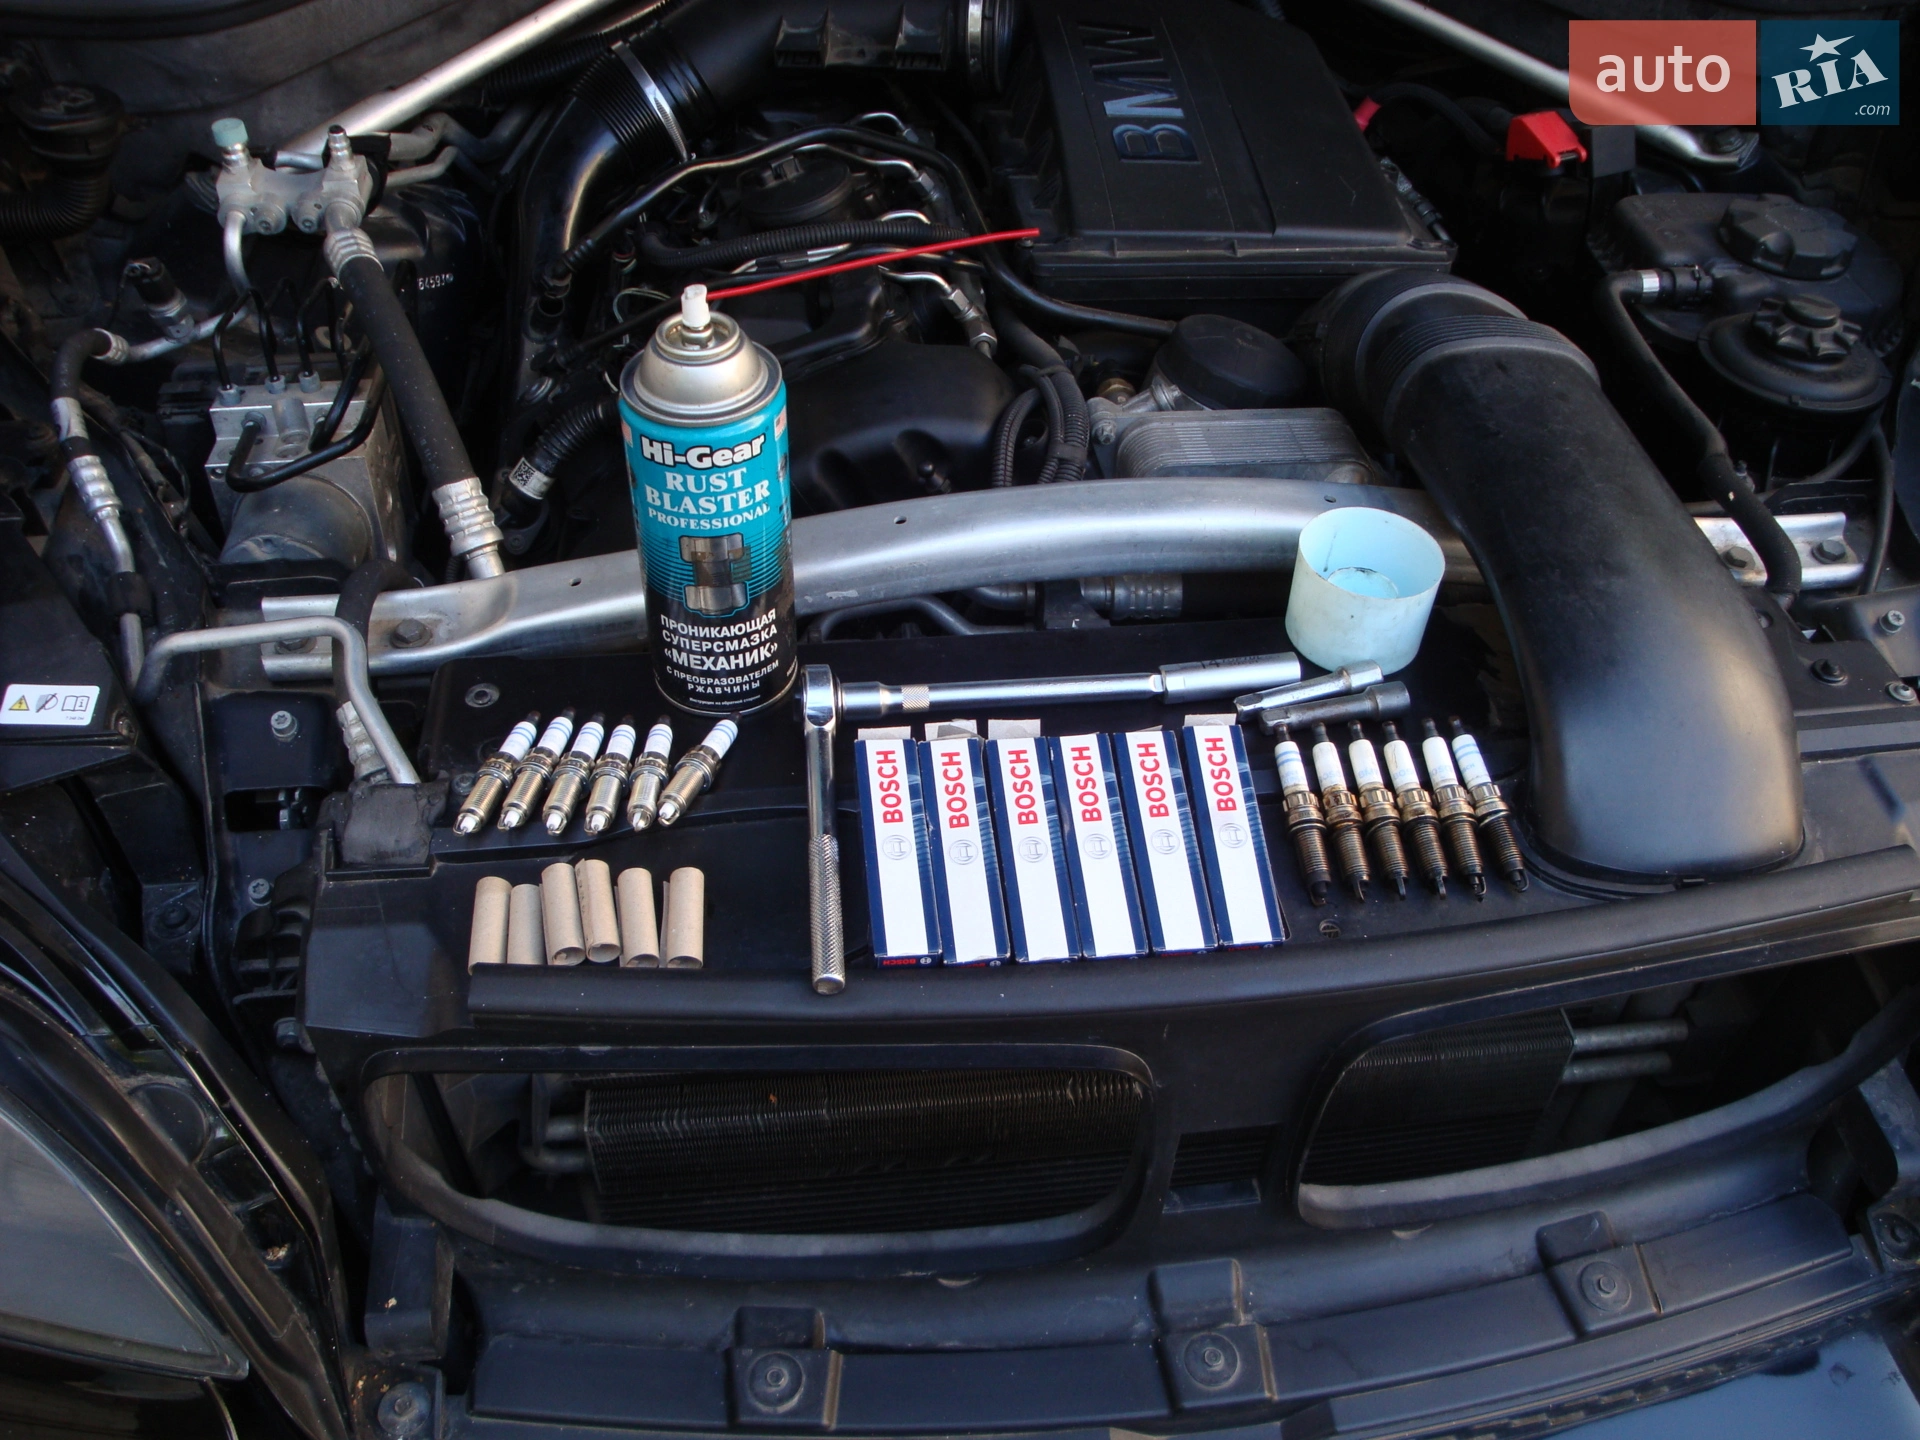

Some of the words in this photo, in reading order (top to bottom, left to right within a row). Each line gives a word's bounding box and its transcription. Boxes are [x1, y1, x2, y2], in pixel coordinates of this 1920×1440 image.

[1075, 20, 1201, 164] BMW
[640, 434, 766, 469] Hi-Gear
[645, 480, 771, 515] BLASTER
[665, 467, 747, 493] RUST
[647, 502, 771, 530] PROFESSIONAL
[660, 608, 776, 638] ПРОНИКАЮЩАЯ
[662, 624, 778, 653] СУПЕРСМАЗКА
[664, 642, 778, 671] «МЕХАНИК»
[666, 665, 673, 674] С
[674, 659, 779, 685] ПРЕОБРАЗОВАТЕЛЕМ
[687, 680, 760, 694] РЖАВЧИНЫ
[876, 751, 903, 823] BOSCH
[941, 752, 969, 828] BOSCH
[1008, 750, 1038, 824] BOSCH
[1071, 747, 1102, 822] BOSCH
[1138, 743, 1169, 817] BOSCH
[1205, 738, 1236, 811] BOSCH
[883, 958, 918, 966] BOSCH
